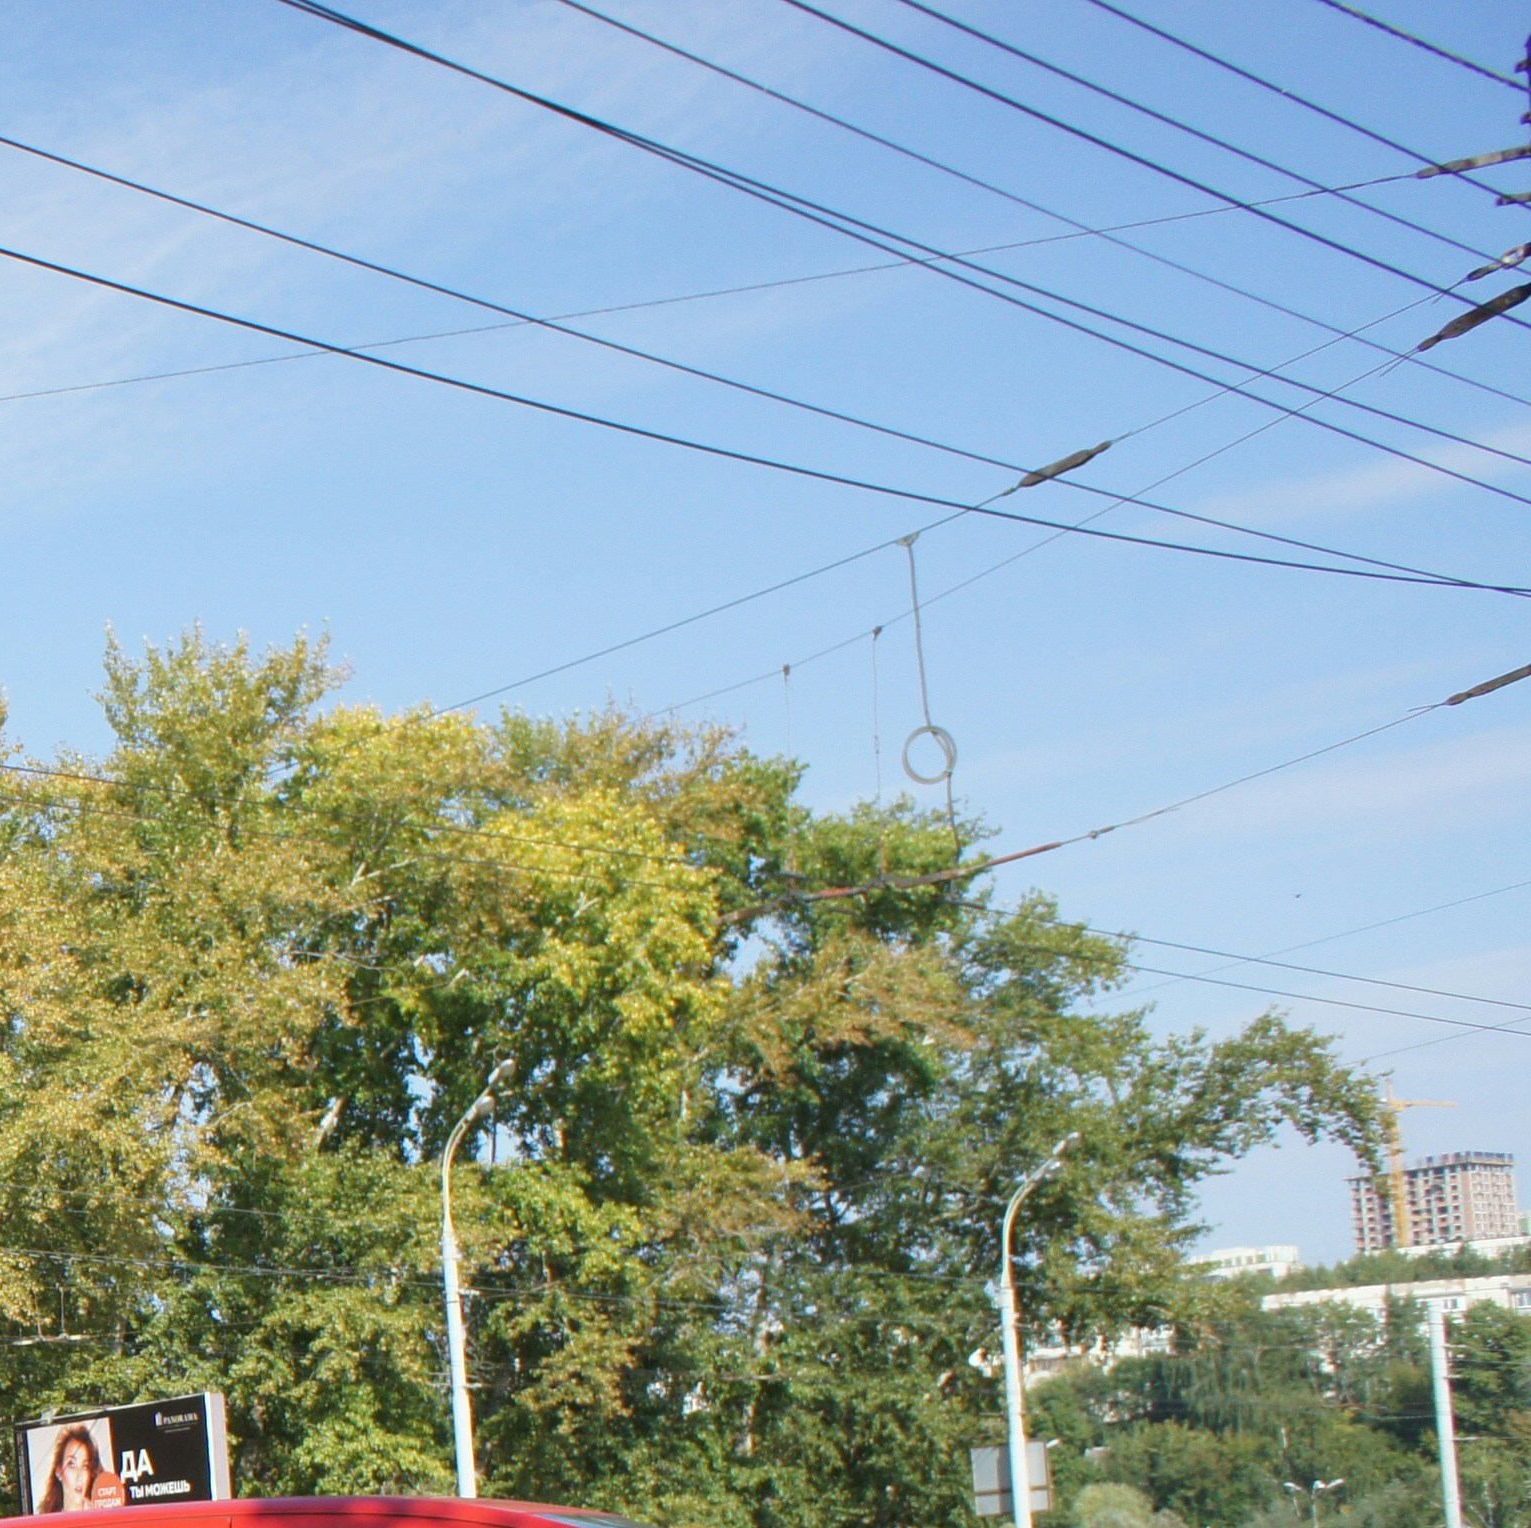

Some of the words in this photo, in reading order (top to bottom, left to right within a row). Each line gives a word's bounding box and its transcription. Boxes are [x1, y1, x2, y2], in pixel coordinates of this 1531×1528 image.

[120, 1448, 154, 1484] ДА
[129, 1485, 144, 1499] ТЫ
[145, 1480, 191, 1497] МОЖЕШЬ
